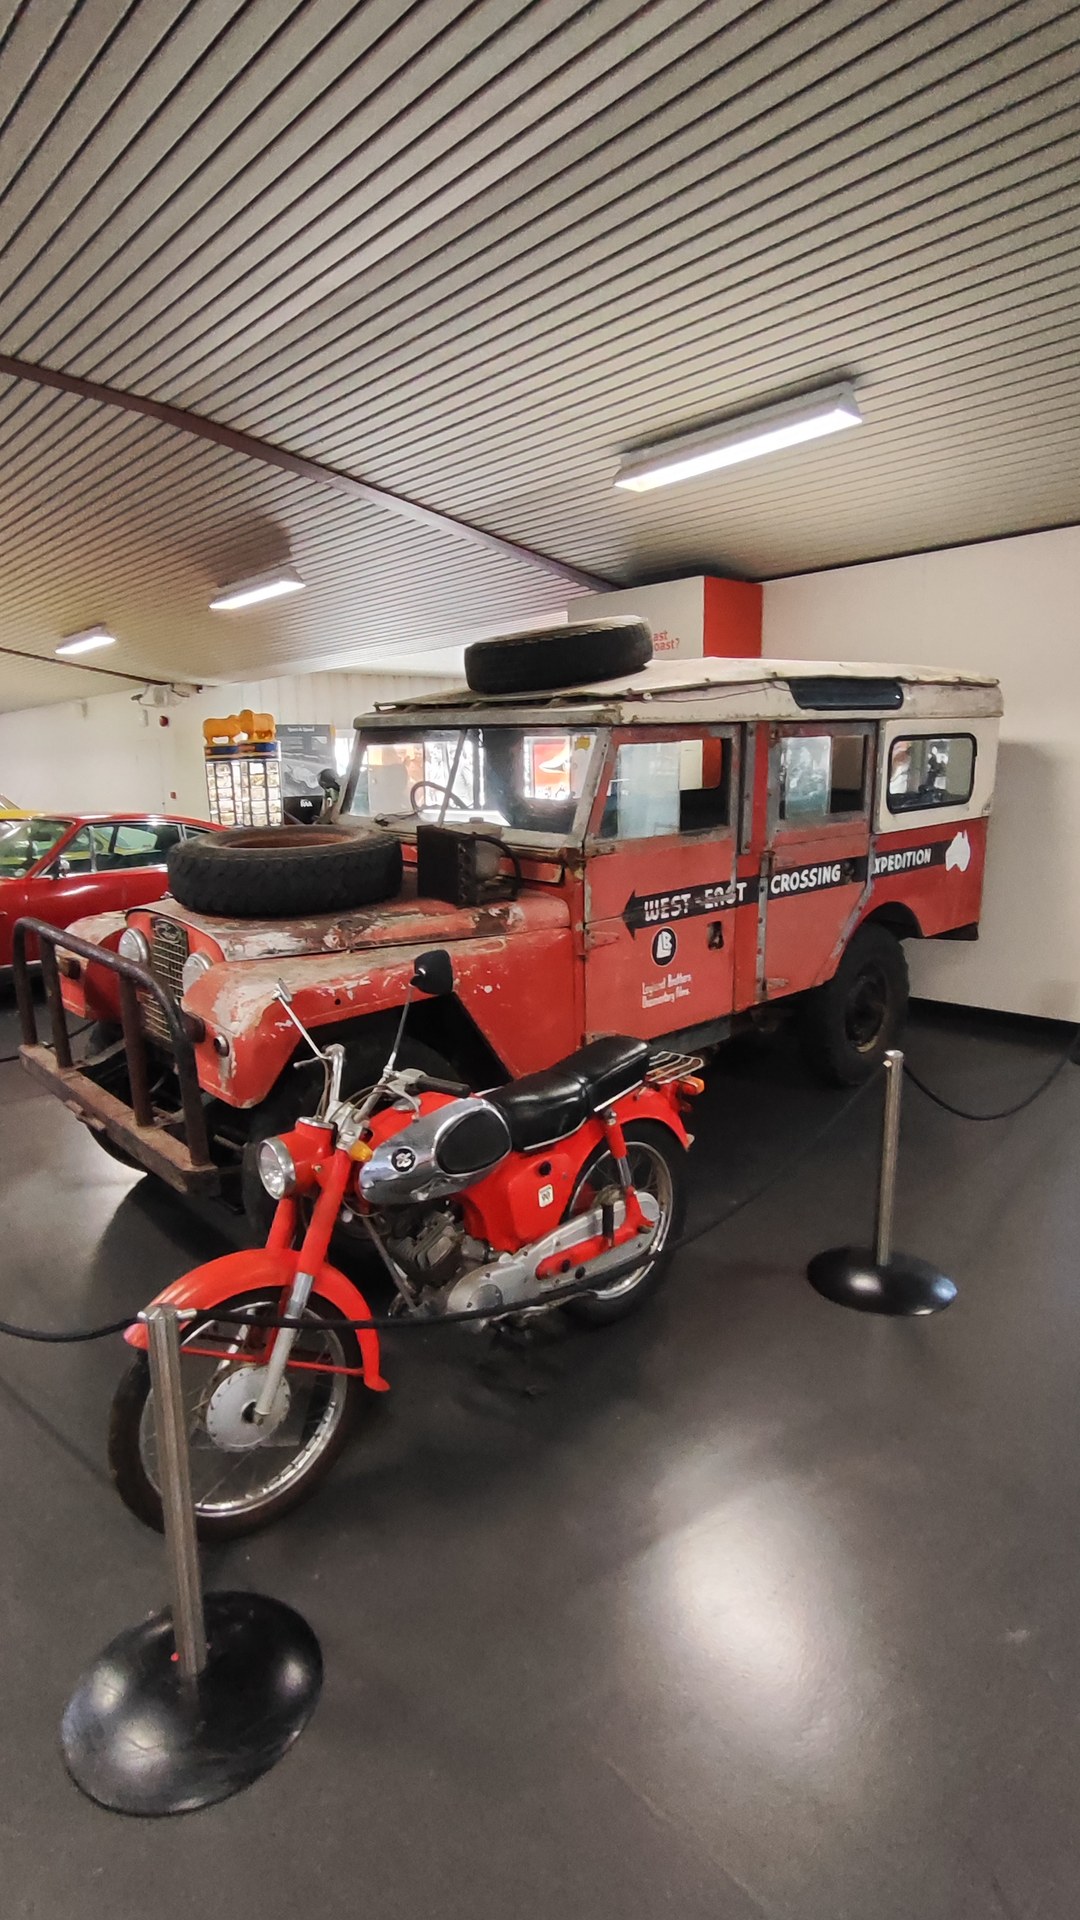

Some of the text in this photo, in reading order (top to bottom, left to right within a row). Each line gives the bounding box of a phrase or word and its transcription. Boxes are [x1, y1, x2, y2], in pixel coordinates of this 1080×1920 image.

[653, 631, 668, 642] ast
[654, 637, 680, 651] oast?
[770, 864, 841, 894] CROSSING
[871, 848, 932, 874] XPEDITION
